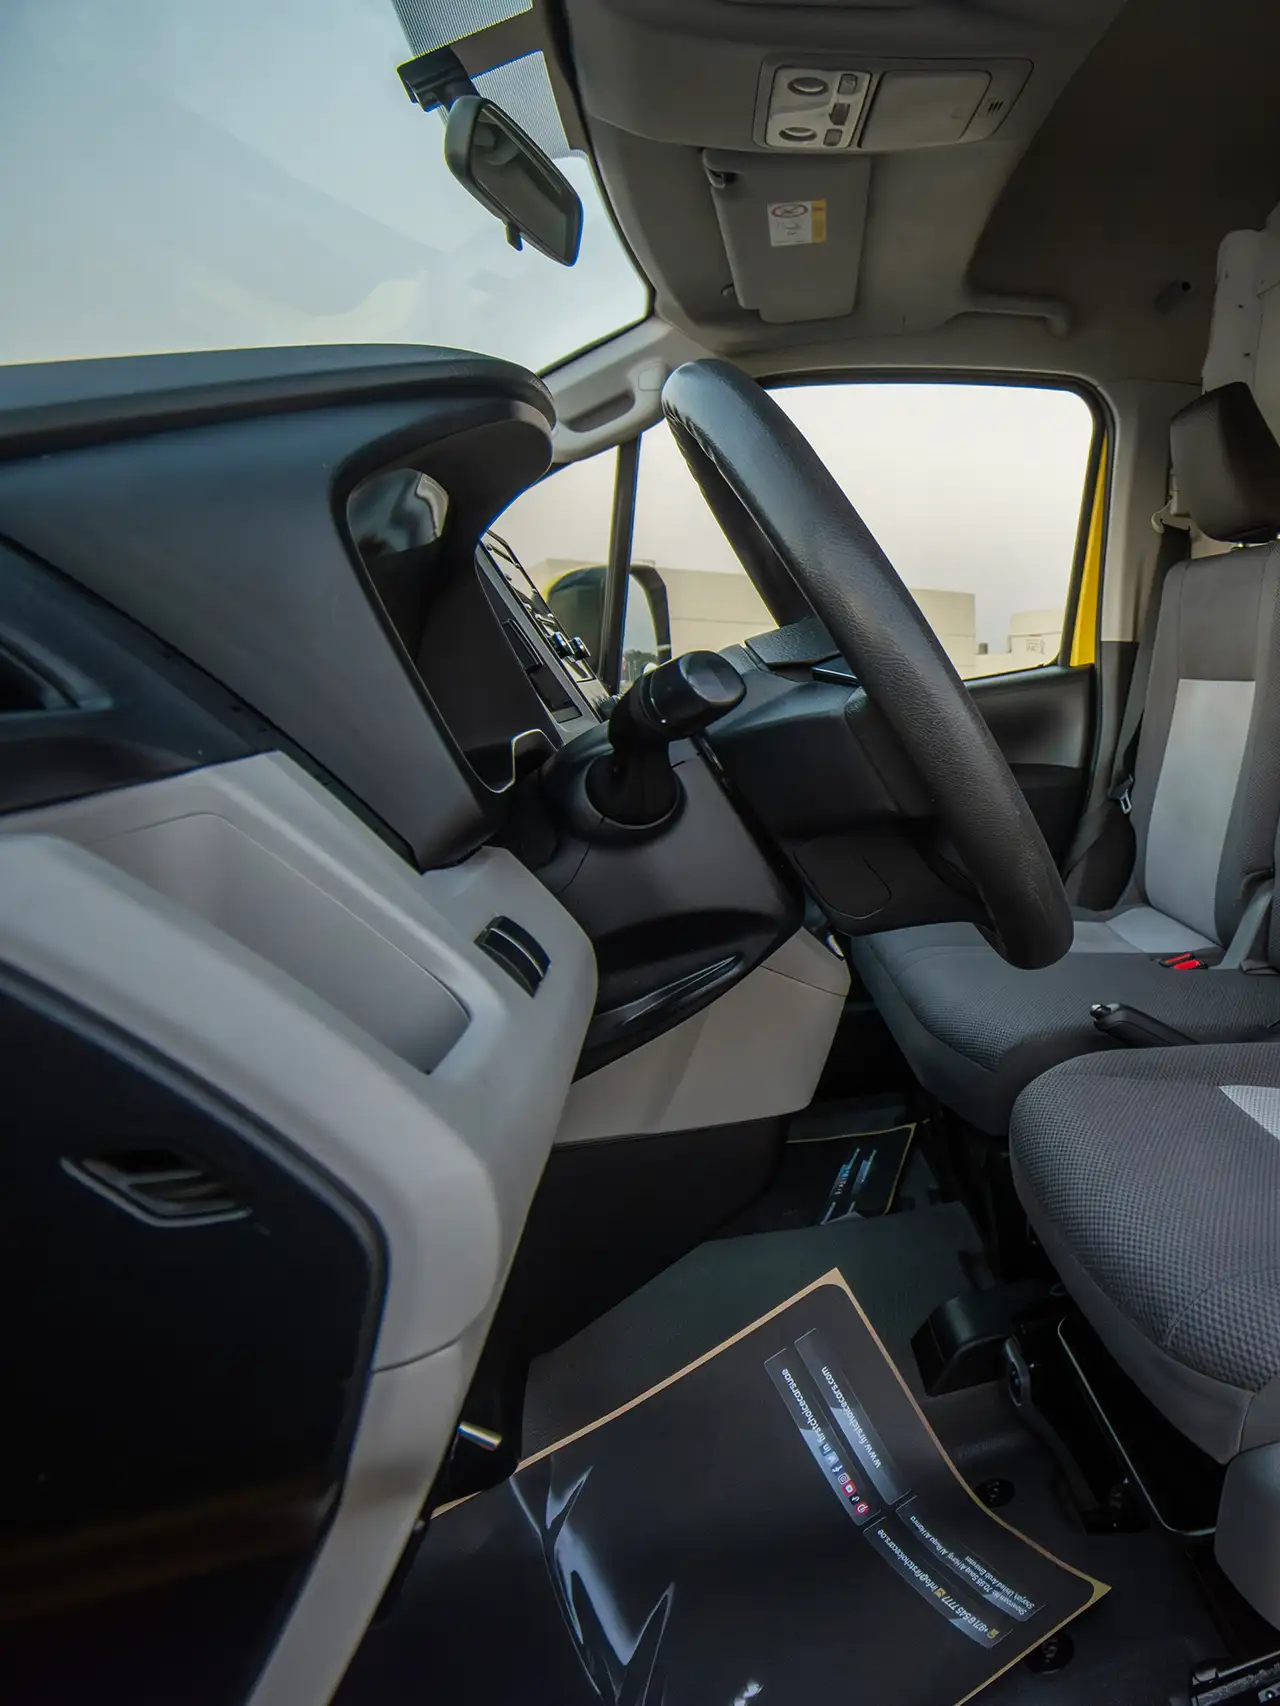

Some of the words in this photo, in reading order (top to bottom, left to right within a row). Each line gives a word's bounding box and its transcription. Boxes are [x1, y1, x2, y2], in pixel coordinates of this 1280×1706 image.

[820, 1365, 882, 1469] www.firstchoicecars.com
[940, 1594, 959, 1610] 7777
[954, 1605, 972, 1620] 545
